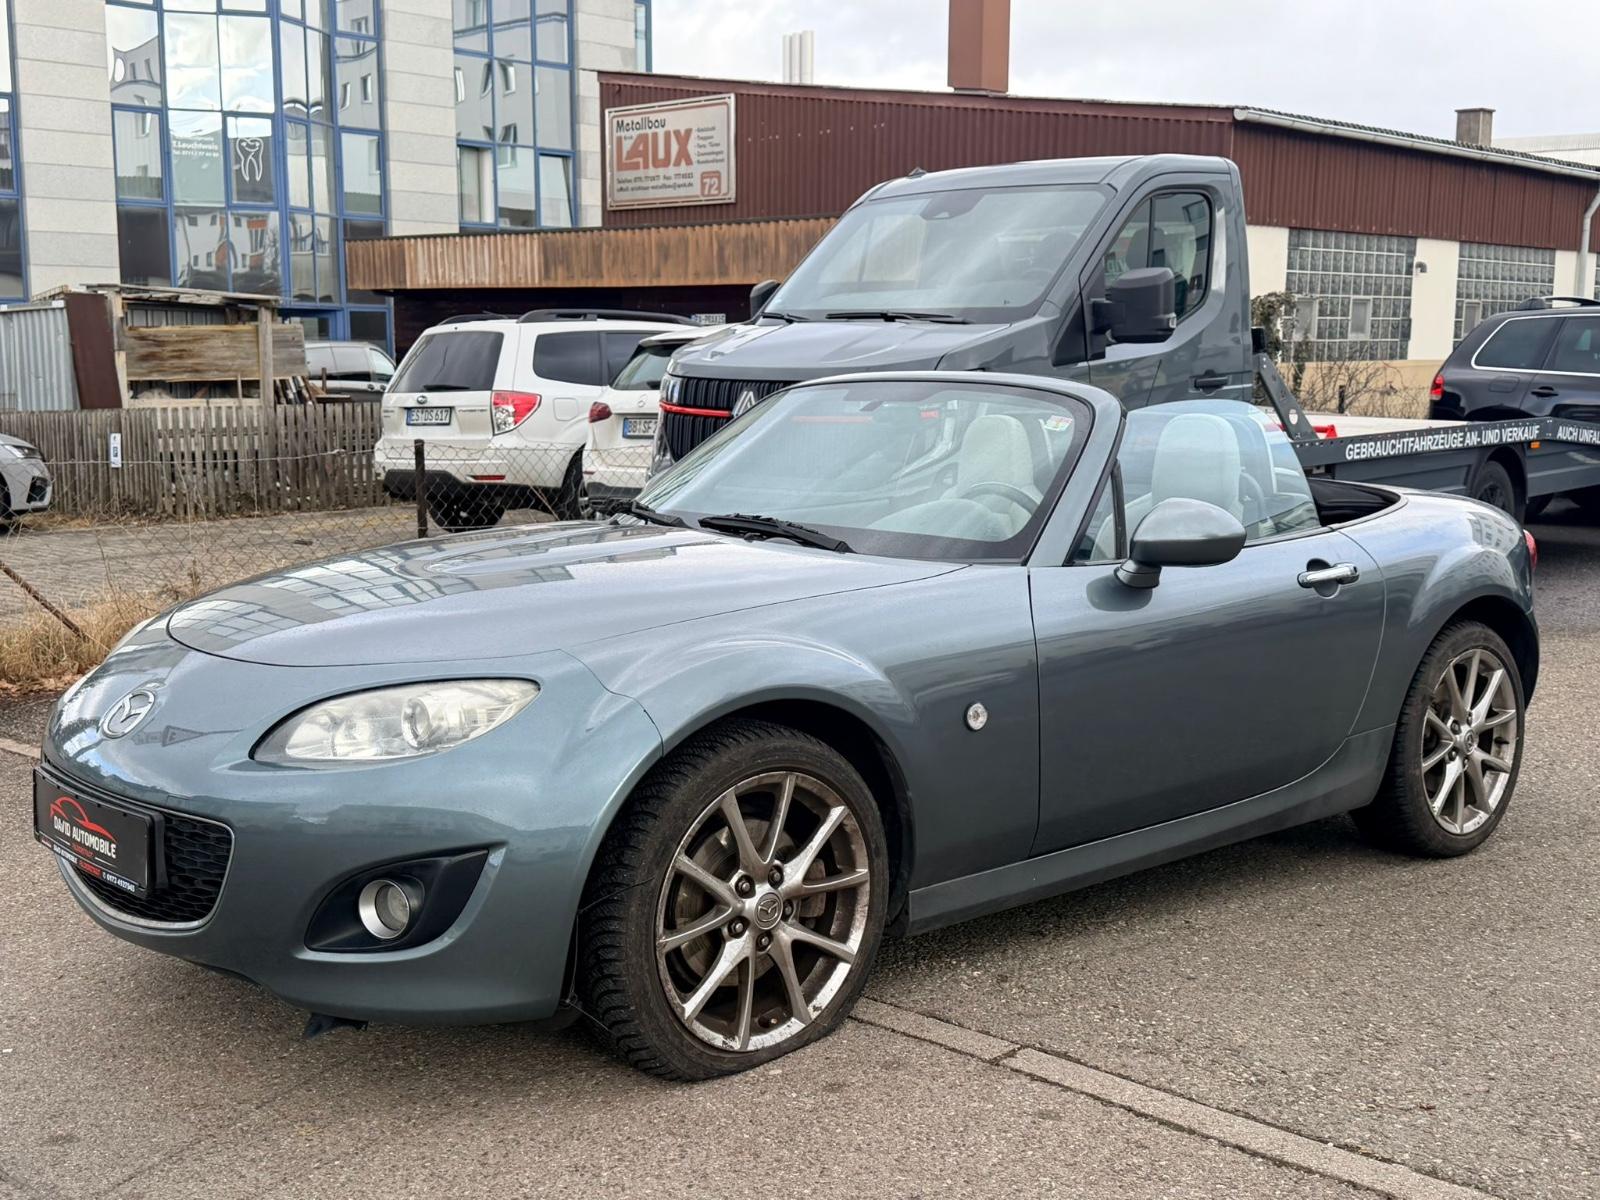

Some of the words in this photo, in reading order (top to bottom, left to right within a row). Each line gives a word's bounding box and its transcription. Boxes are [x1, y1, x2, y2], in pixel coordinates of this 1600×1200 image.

[616, 116, 666, 133] Metallbau
[616, 128, 693, 172] LAUX
[703, 177, 720, 196] 72
[424, 409, 434, 422] DS
[434, 409, 450, 421] 617
[1345, 432, 1463, 461] GEBRAUCHTFAHRZEUGE
[1464, 431, 1481, 447] AN-
[1482, 428, 1500, 444] UND
[1502, 424, 1541, 442] VERKAUF
[1556, 425, 1579, 441] AUCH
[53, 815, 71, 837] DAVID
[72, 826, 117, 859] AUTOMOBILE
